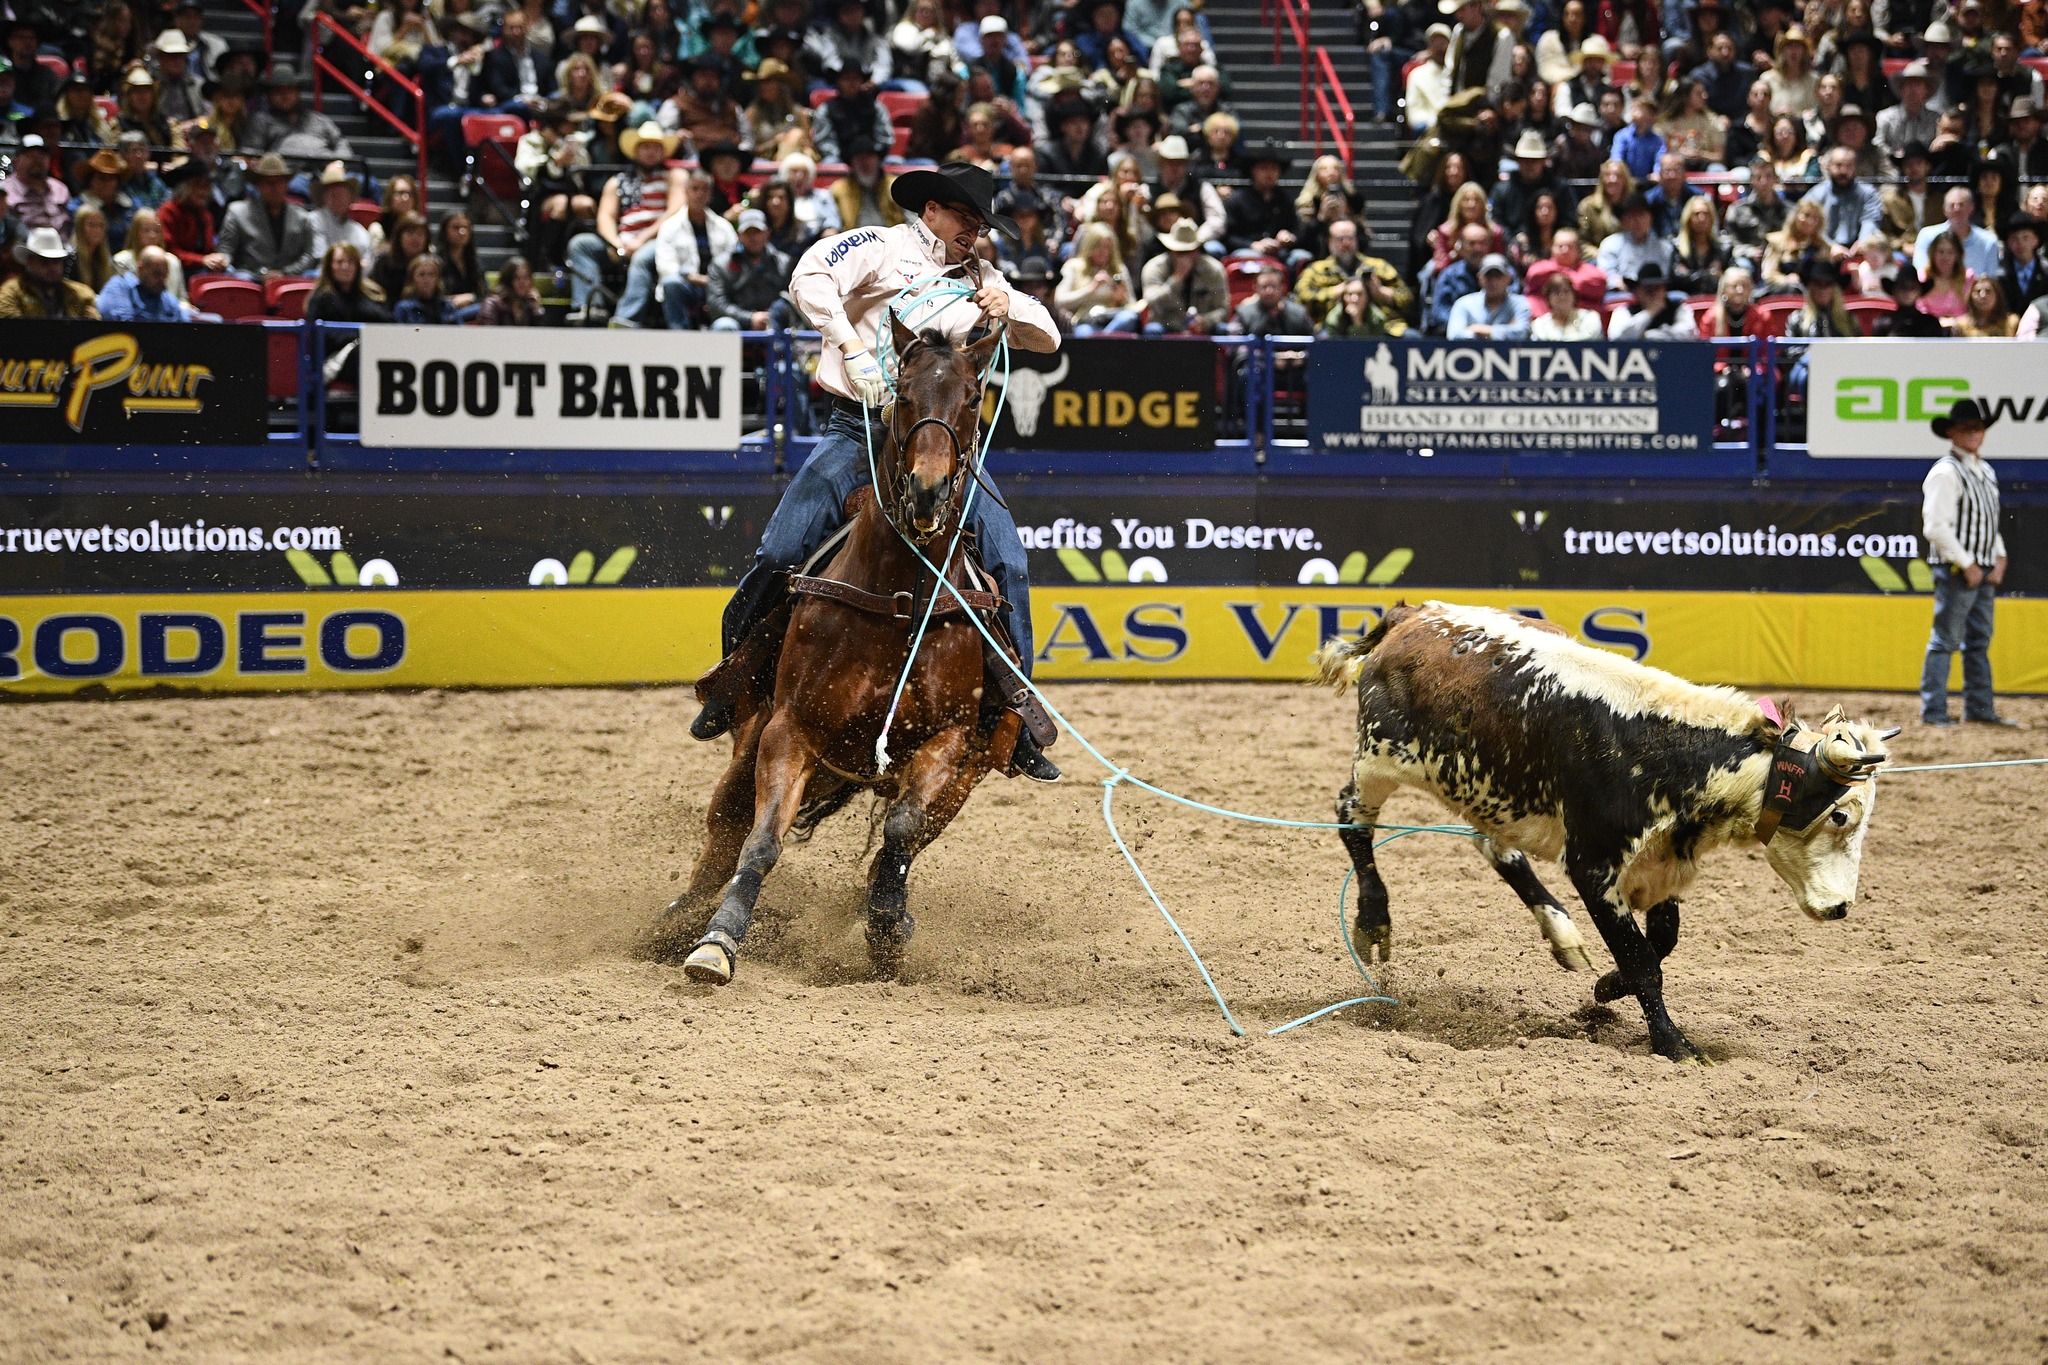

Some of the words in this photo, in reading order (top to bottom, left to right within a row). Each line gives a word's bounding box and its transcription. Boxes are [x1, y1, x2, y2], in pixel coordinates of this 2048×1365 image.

[824, 230, 885, 267] Wrangler
[1406, 348, 1656, 381] MONTANA
[376, 360, 546, 418] BOOT
[559, 363, 724, 419] BARN
[1406, 386, 1658, 403] SILVERSMITHS
[1053, 390, 1200, 428] RIDGE
[1366, 410, 1453, 427] BRAND
[1461, 410, 1492, 427] OF
[1501, 410, 1650, 428] CHAMPIONS
[1016, 518, 1102, 549] nefits
[1112, 518, 1175, 549] You
[1185, 518, 1323, 550] Deserve.
[1564, 526, 1918, 557] truevetsolutions.com
[0, 610, 407, 681] ODEO
[1034, 603, 1189, 663] AS
